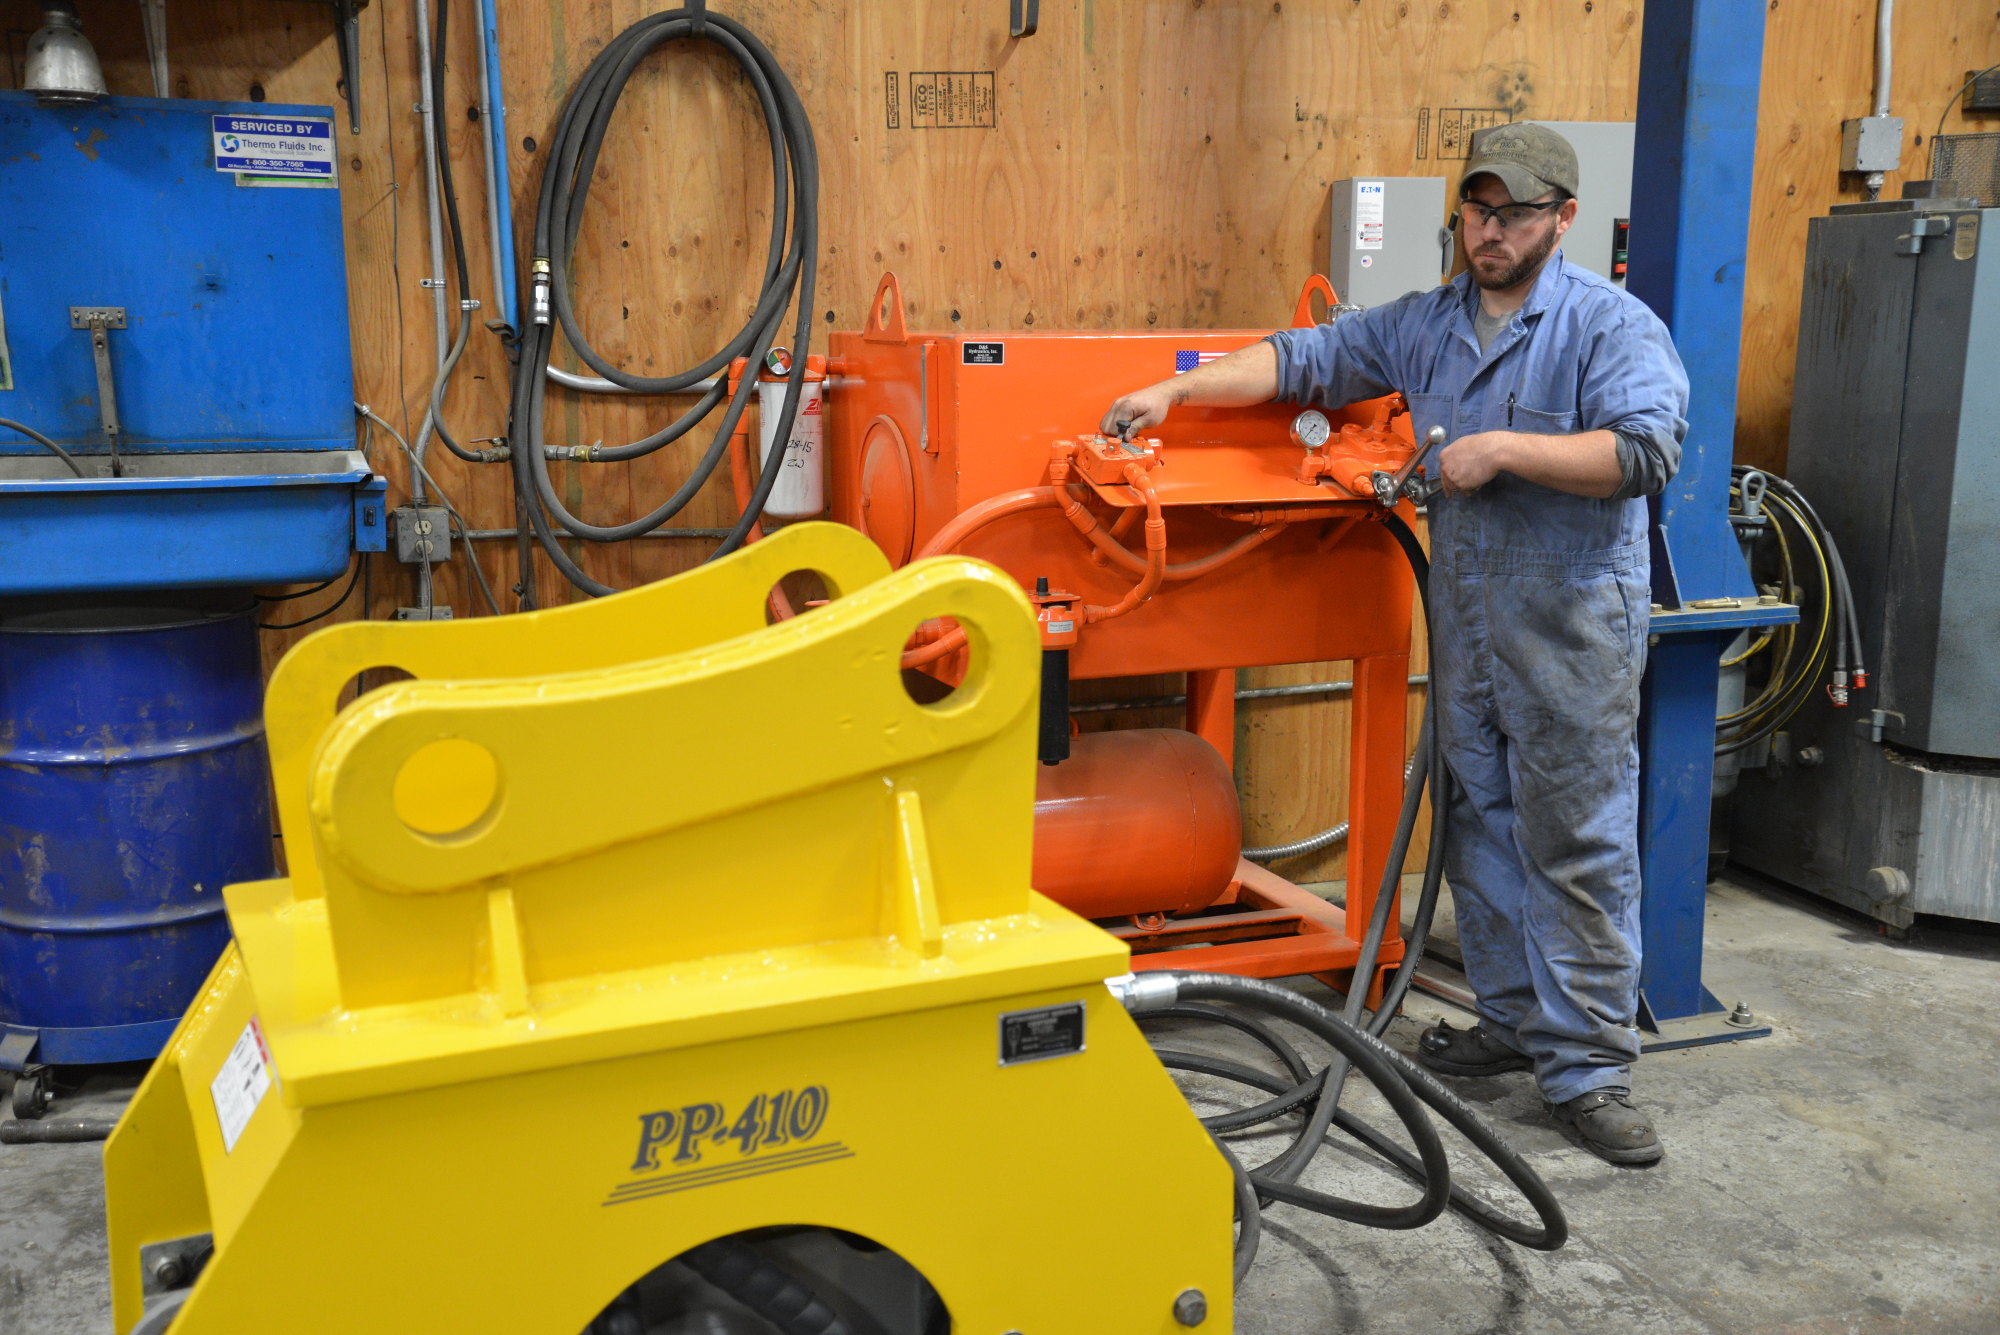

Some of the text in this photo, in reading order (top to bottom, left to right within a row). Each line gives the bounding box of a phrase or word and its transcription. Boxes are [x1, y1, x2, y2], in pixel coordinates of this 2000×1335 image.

[918, 84, 927, 116] TECO
[231, 121, 313, 134] SERVICED BY
[241, 139, 326, 152] Thermo Fluids Inc.
[630, 1085, 829, 1172] PP-410
